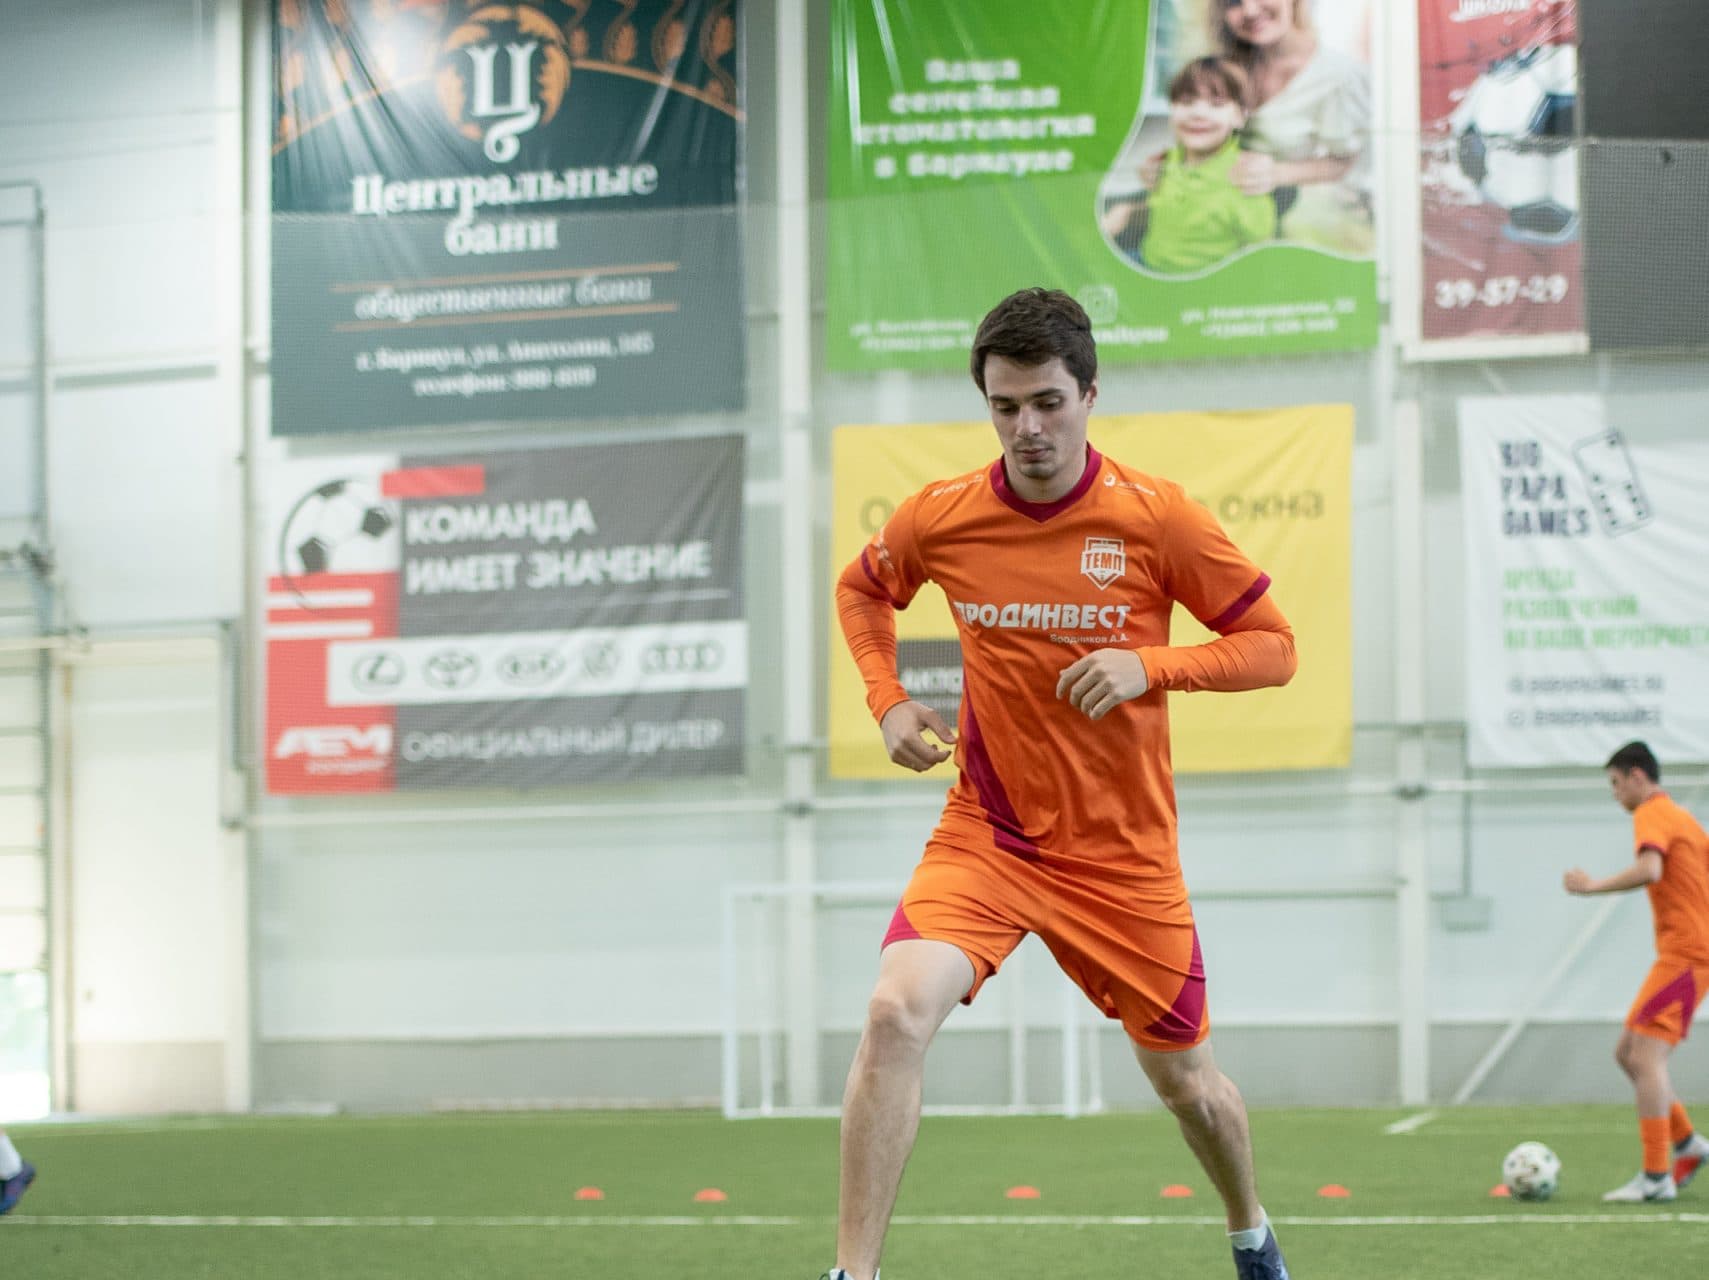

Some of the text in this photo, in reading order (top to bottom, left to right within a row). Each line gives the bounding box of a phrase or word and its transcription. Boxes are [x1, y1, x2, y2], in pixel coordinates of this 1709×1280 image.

[924, 59, 1019, 83] Ваша
[889, 83, 1060, 113] семейная
[858, 113, 1096, 144] стоматология
[907, 149, 1074, 180] Барнауле
[351, 163, 658, 224] Центральные
[445, 217, 559, 256] бани
[406, 499, 597, 545] КОМАНДА
[407, 541, 712, 594] ИМЕЕТ ЗНАЧЕНИЕ
[1086, 553, 1122, 570] ТЕМП
[402, 719, 626, 762] ОФИЦИАЛЬНЫЙ
